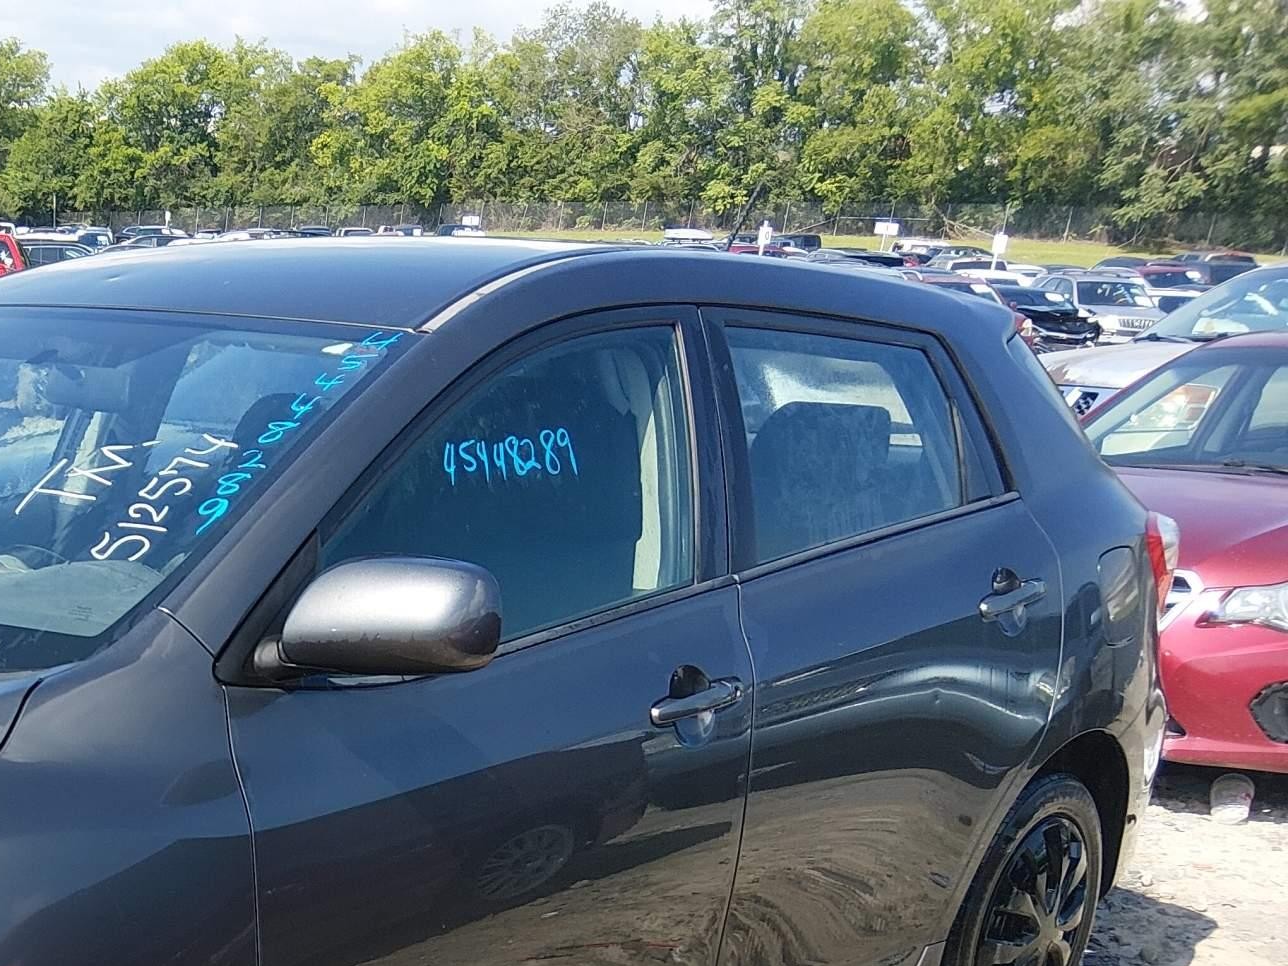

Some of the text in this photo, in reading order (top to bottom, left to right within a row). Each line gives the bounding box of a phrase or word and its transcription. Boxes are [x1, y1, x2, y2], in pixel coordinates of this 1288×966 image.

[90, 433, 239, 562] 512574
[196, 331, 404, 536] 45448289
[443, 427, 578, 487] 45448289
